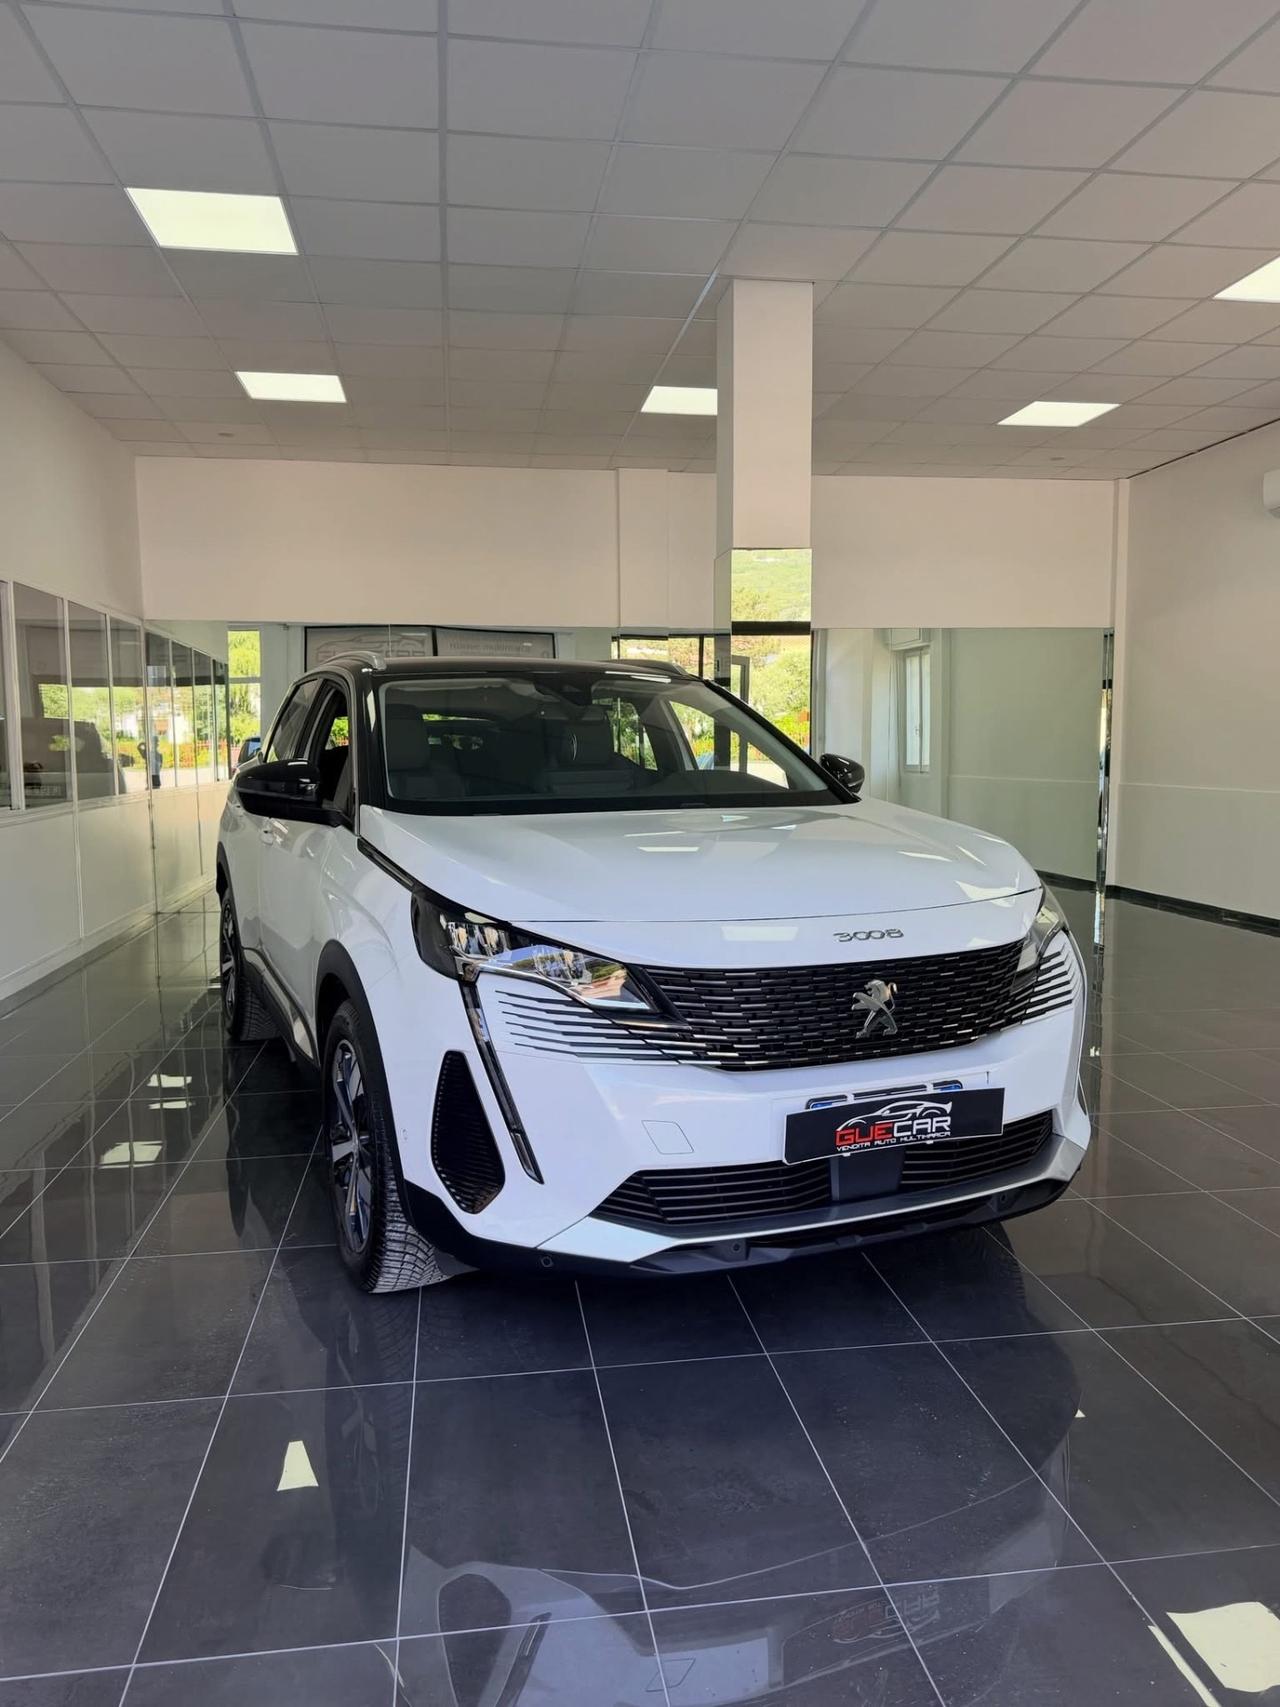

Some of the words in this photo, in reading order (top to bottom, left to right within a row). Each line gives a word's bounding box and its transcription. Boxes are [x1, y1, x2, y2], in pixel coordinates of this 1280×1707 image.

[833, 928, 905, 943] 3008
[835, 1116, 951, 1146] GUECAR
[836, 1141, 871, 1152] VENDITA
[874, 1138, 897, 1146] AUTO
